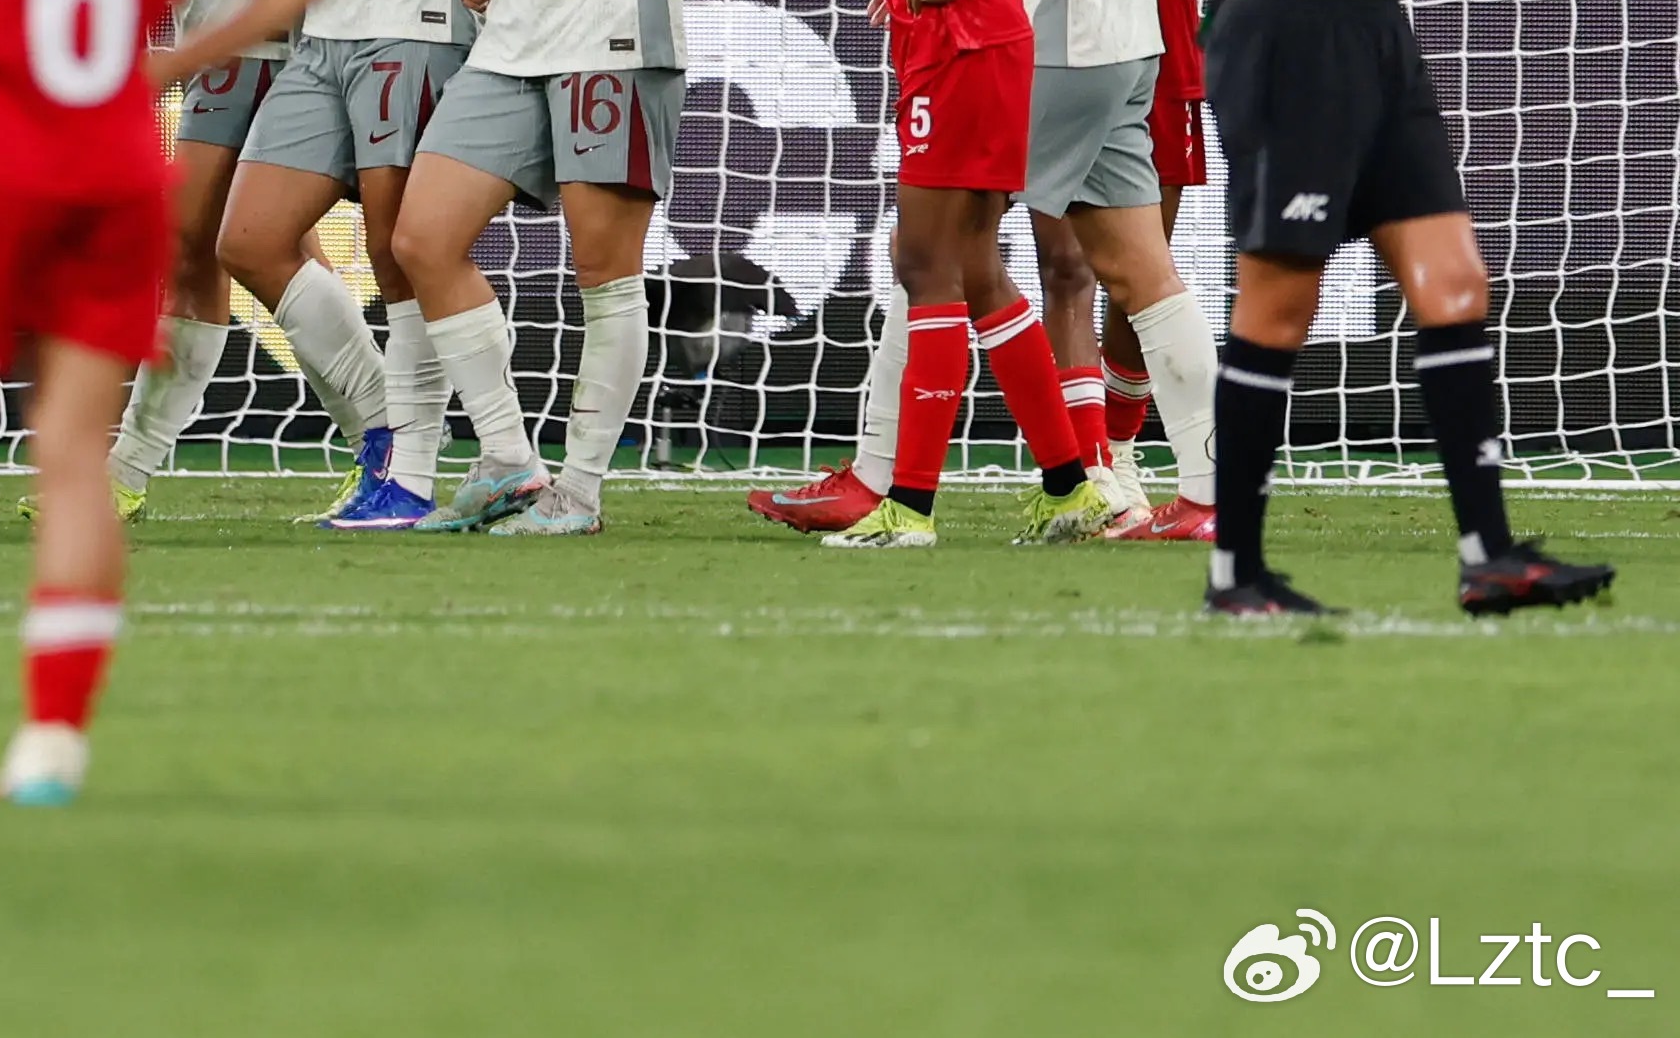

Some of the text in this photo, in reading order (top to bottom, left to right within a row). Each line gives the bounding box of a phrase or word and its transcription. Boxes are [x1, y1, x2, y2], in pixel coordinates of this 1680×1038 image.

[372, 61, 402, 122] 7
[560, 73, 623, 136] 16
[910, 96, 932, 139] 5
